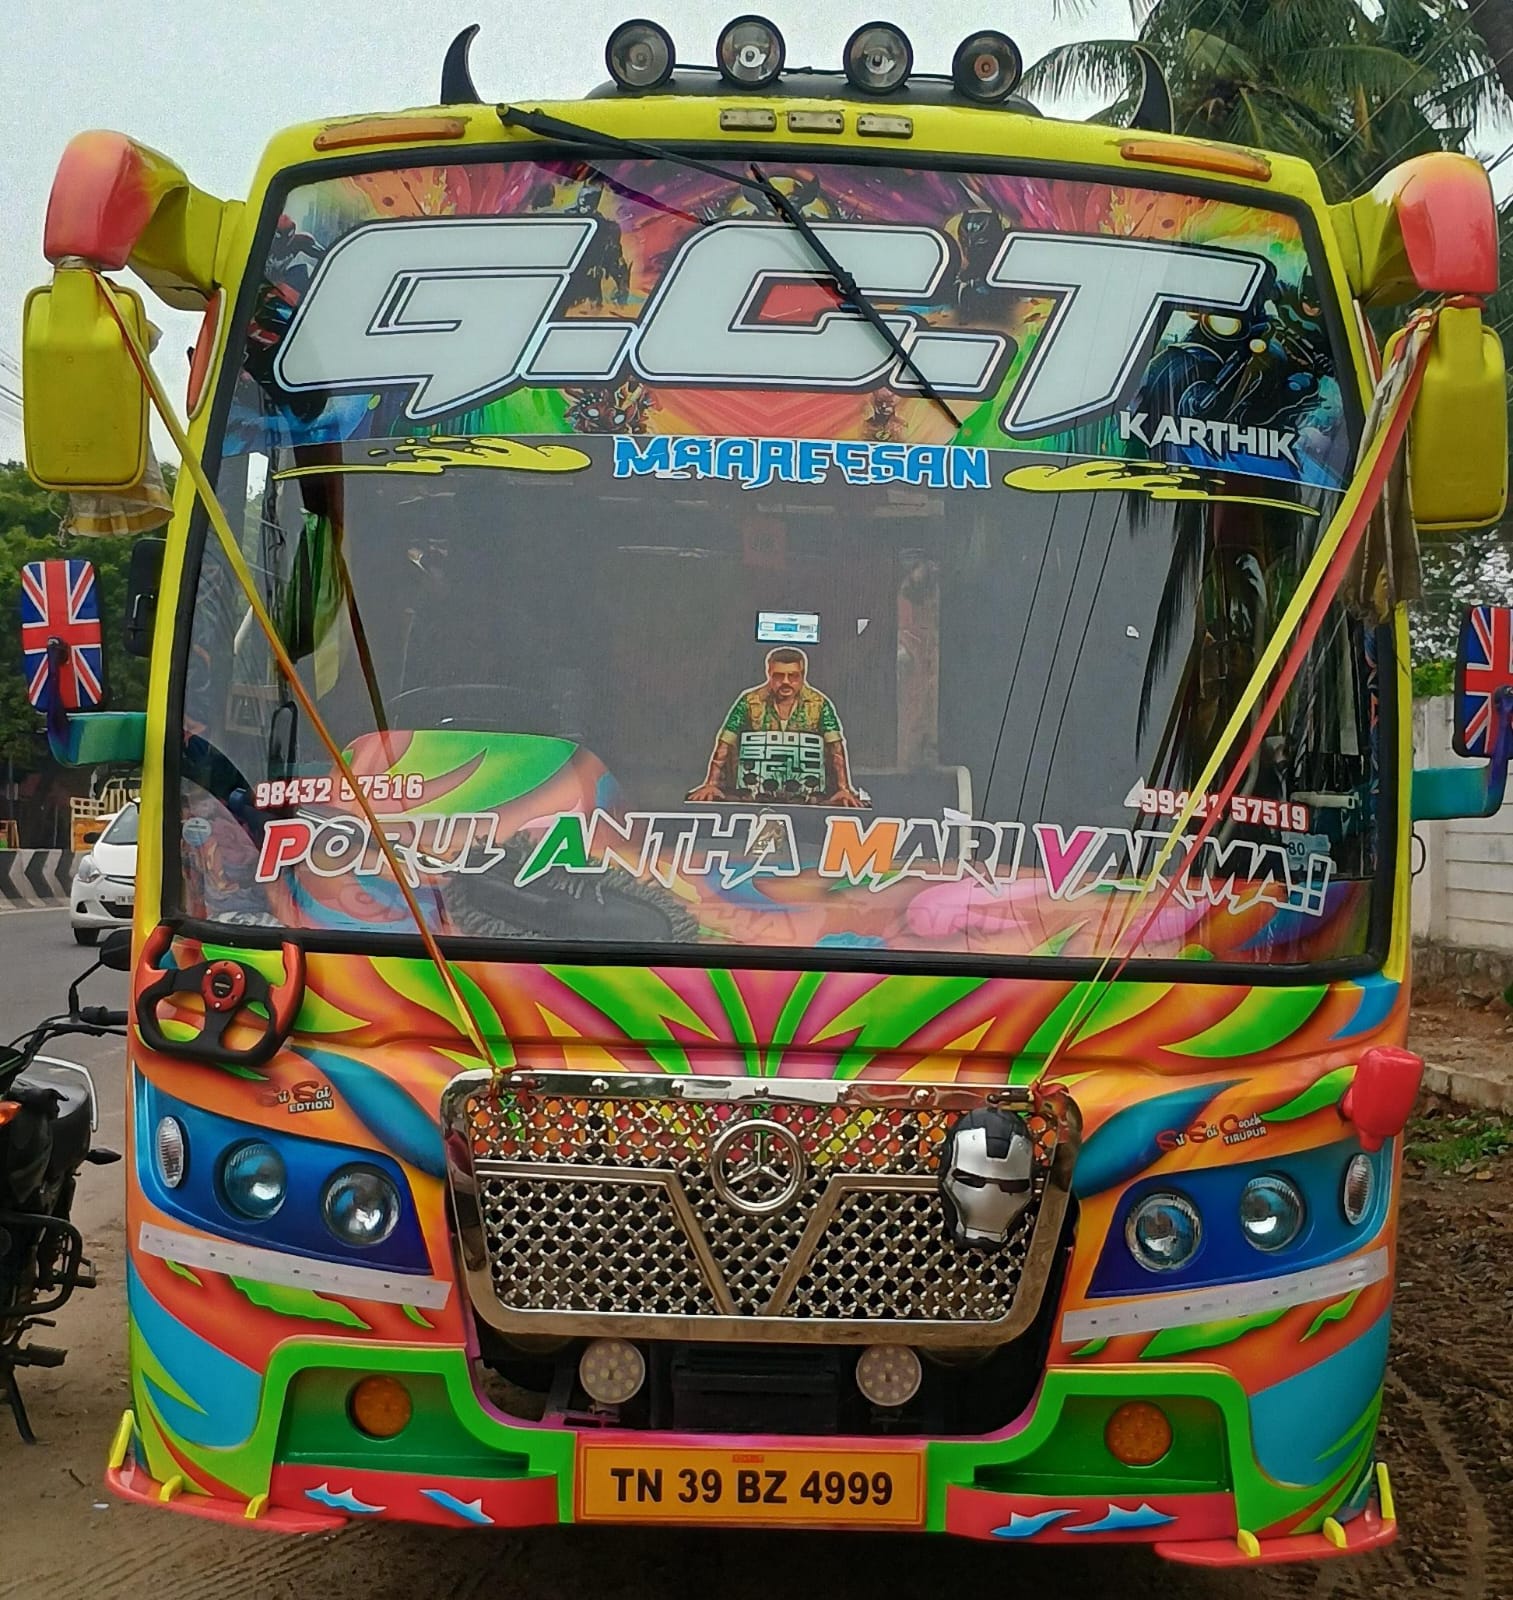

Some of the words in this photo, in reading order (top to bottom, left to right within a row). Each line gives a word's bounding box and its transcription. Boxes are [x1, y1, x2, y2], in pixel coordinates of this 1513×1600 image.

[1119, 410, 1299, 465] KARTHIK
[255, 777, 332, 807] 98432
[340, 774, 424, 801] 57516
[1231, 796, 1309, 832] 57519
[818, 815, 1025, 897] MARI
[1288, 841, 1305, 856] 80
[291, 1080, 333, 1102] Sai
[1223, 1127, 1268, 1145] TIRUPUR
[611, 1468, 662, 1502] TN
[678, 1468, 722, 1503] 39
[737, 1470, 787, 1503] BZ
[800, 1470, 893, 1505] 4999
